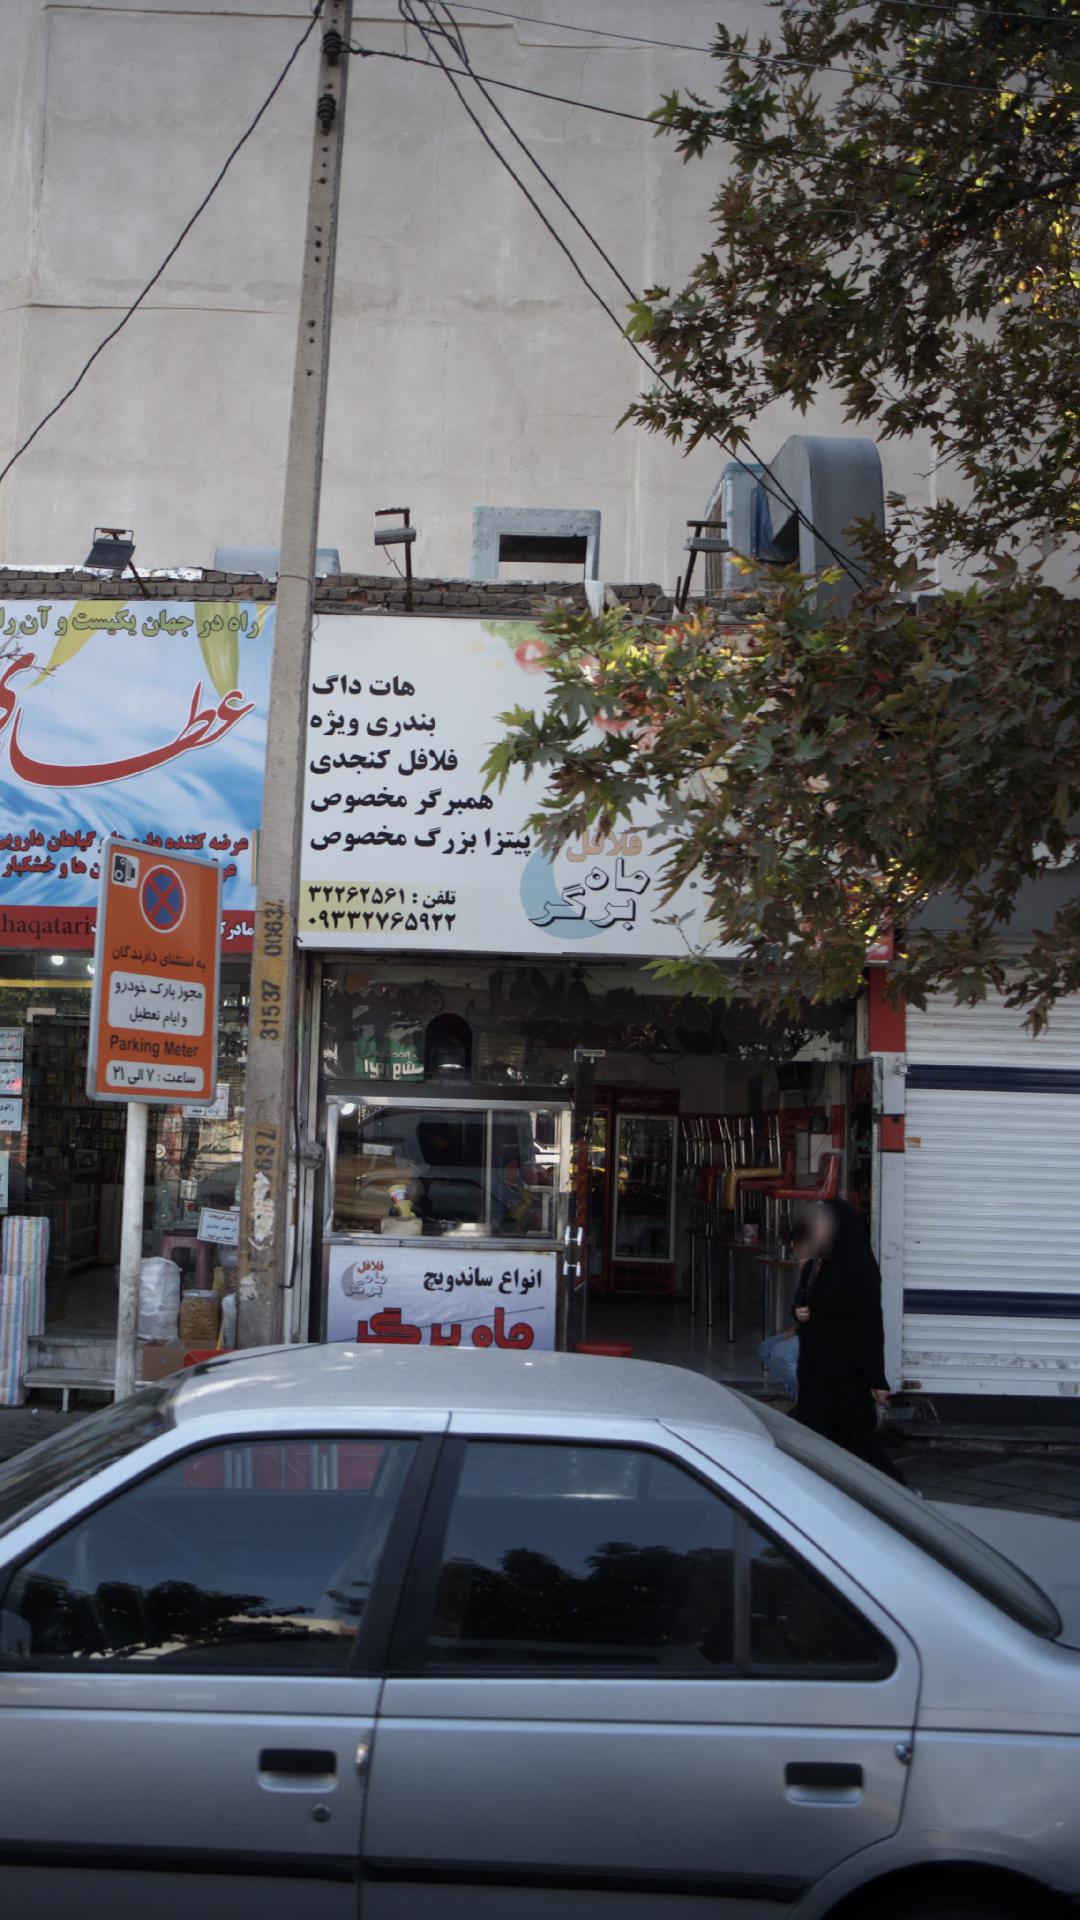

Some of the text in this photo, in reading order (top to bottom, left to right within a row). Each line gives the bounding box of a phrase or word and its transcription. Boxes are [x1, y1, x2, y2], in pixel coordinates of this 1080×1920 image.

[20, 606, 52, 636] آن
[55, 616, 68, 636] و
[72, 609, 137, 636] یکیست
[142, 609, 194, 637] جهان
[198, 615, 224, 638] در
[228, 611, 259, 638] راه
[312, 675, 415, 696] هات داگ
[310, 709, 436, 737] بندری ویژه
[310, 748, 458, 776] فلافل کنجدی
[310, 786, 494, 815] همبرگر مخصوص
[49, 830, 97, 852] گیاهان
[165, 832, 207, 850] کننده
[209, 833, 249, 856] عرضه
[310, 825, 532, 857] پیتزا بزرگ مخصوص
[2, 856, 56, 878] خشکبار
[58, 861, 69, 878] و
[70, 856, 88, 874] ها
[585, 857, 651, 895] ماه
[308, 885, 405, 906] ۳۲۲۶۲۵۶۱
[423, 890, 457, 909] تلفن
[528, 884, 636, 932] برگر
[308, 910, 457, 931] ۰۹۳۳۲۷۶۵۹۲۲
[112, 945, 207, 973] به استثنای دارندگان
[114, 980, 204, 1003] مجوز پارک خودرو
[129, 1005, 188, 1028] و ایام تعطیل
[259, 981, 280, 1041] 31537
[110, 1034, 200, 1057] Parking Meter
[112, 1066, 125, 1081] ۲۱
[127, 1068, 145, 1085] الی
[145, 1069, 155, 1082] ۷
[163, 1070, 197, 1084] ساعت
[423, 1266, 543, 1295] انواع ساندویچ
[471, 1307, 534, 1349] ماه
